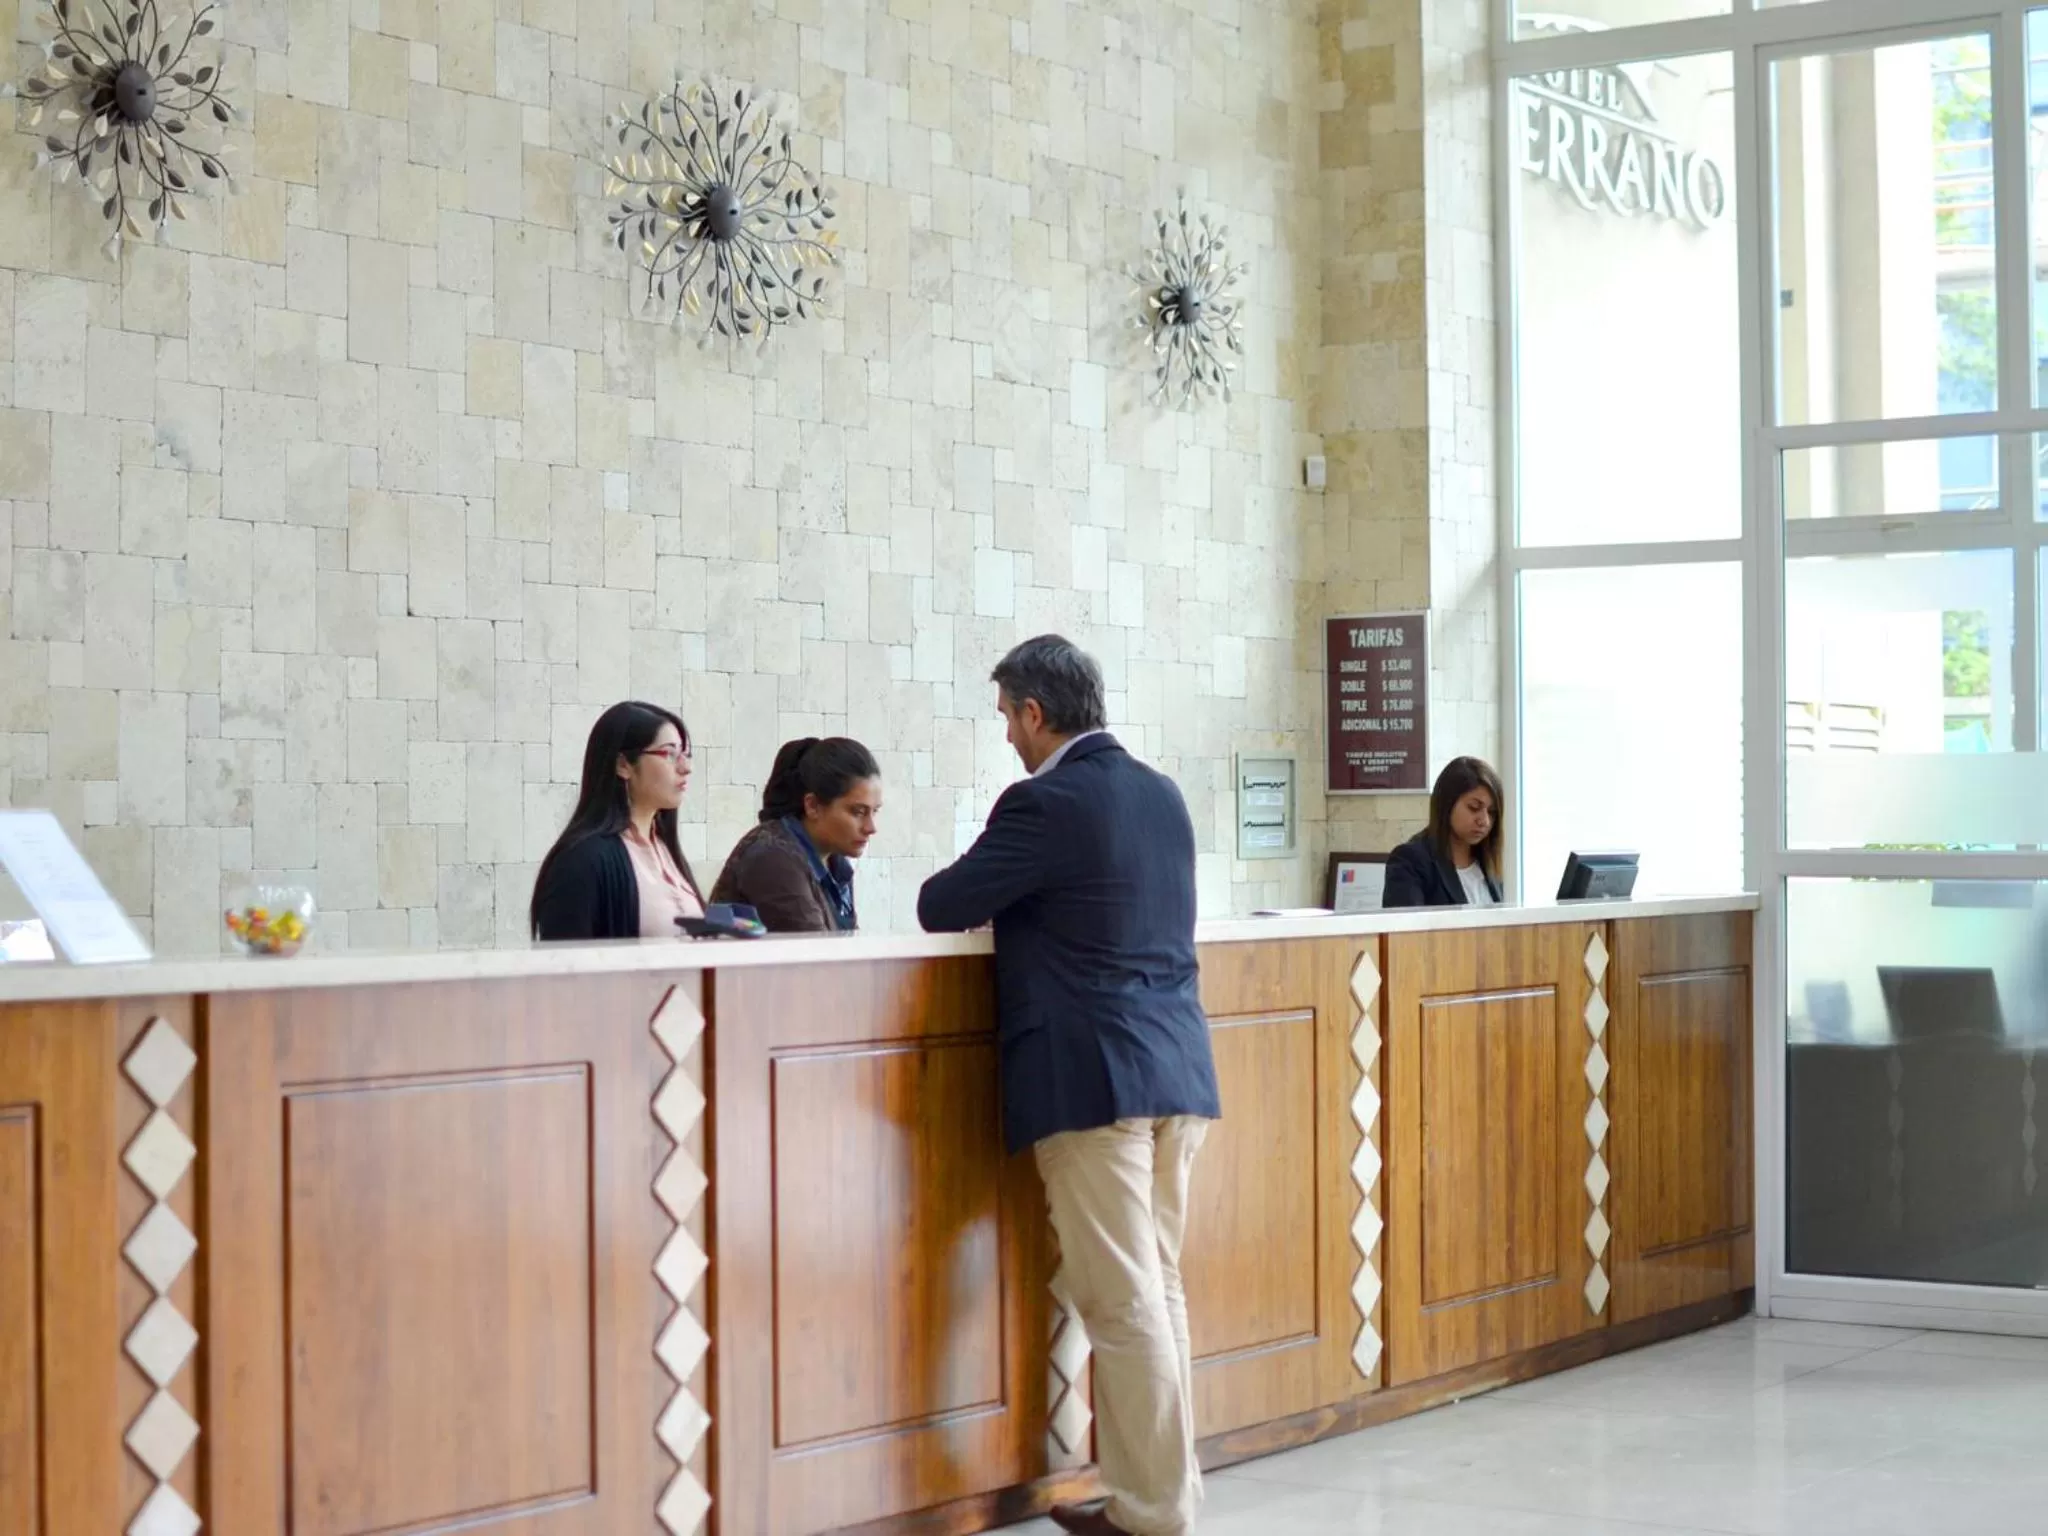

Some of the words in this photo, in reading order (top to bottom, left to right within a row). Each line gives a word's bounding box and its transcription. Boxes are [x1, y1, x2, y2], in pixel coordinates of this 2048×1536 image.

[1529, 67, 1624, 113] TEL
[1349, 628, 1403, 648] TARIFAS
[1340, 680, 1366, 693] DOBLE
[1341, 700, 1367, 712] TRIPLE
[1341, 719, 1380, 732] ADICIONAL
[1382, 719, 1388, 732] $
